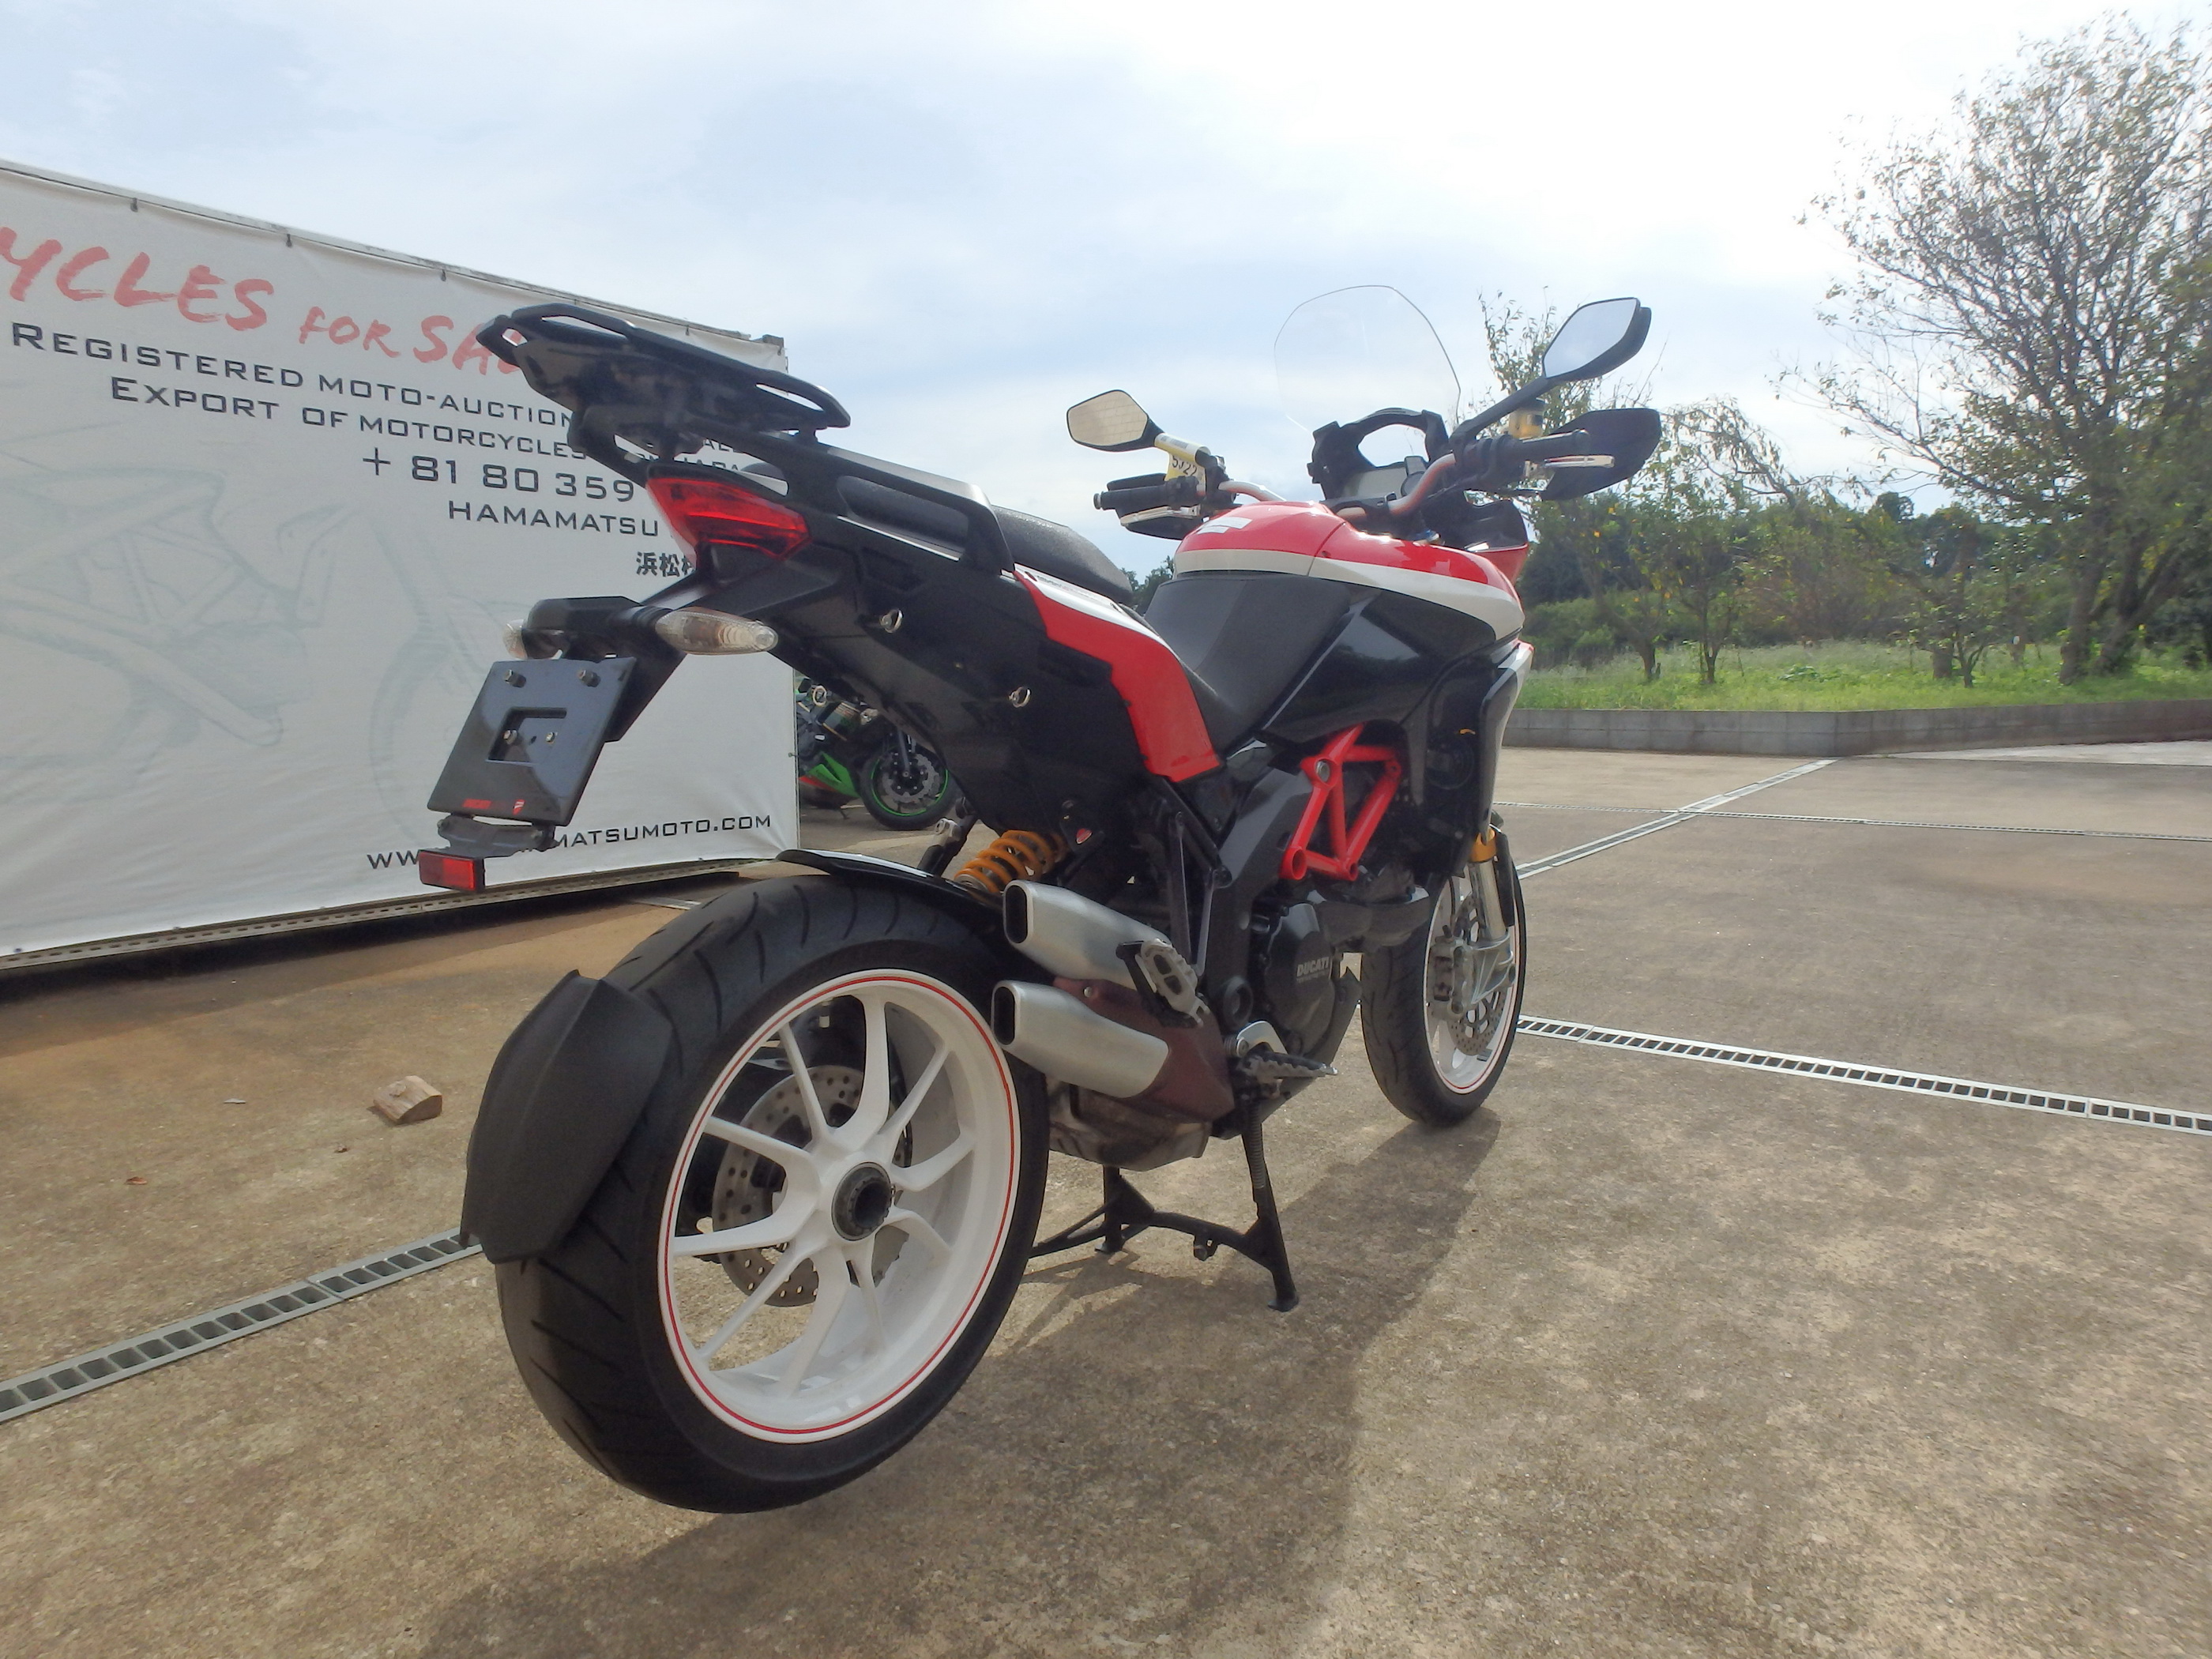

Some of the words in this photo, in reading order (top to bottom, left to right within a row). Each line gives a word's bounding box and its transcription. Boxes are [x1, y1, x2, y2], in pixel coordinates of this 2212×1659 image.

[12, 321, 303, 388] REGISTERED
[299, 307, 401, 358] FOR
[111, 376, 280, 420] EXPORT
[303, 407, 348, 428] OF
[412, 455, 457, 483] 81
[482, 464, 539, 492] 80
[555, 472, 634, 502] 359
[449, 500, 658, 536] HAMAMATSU
